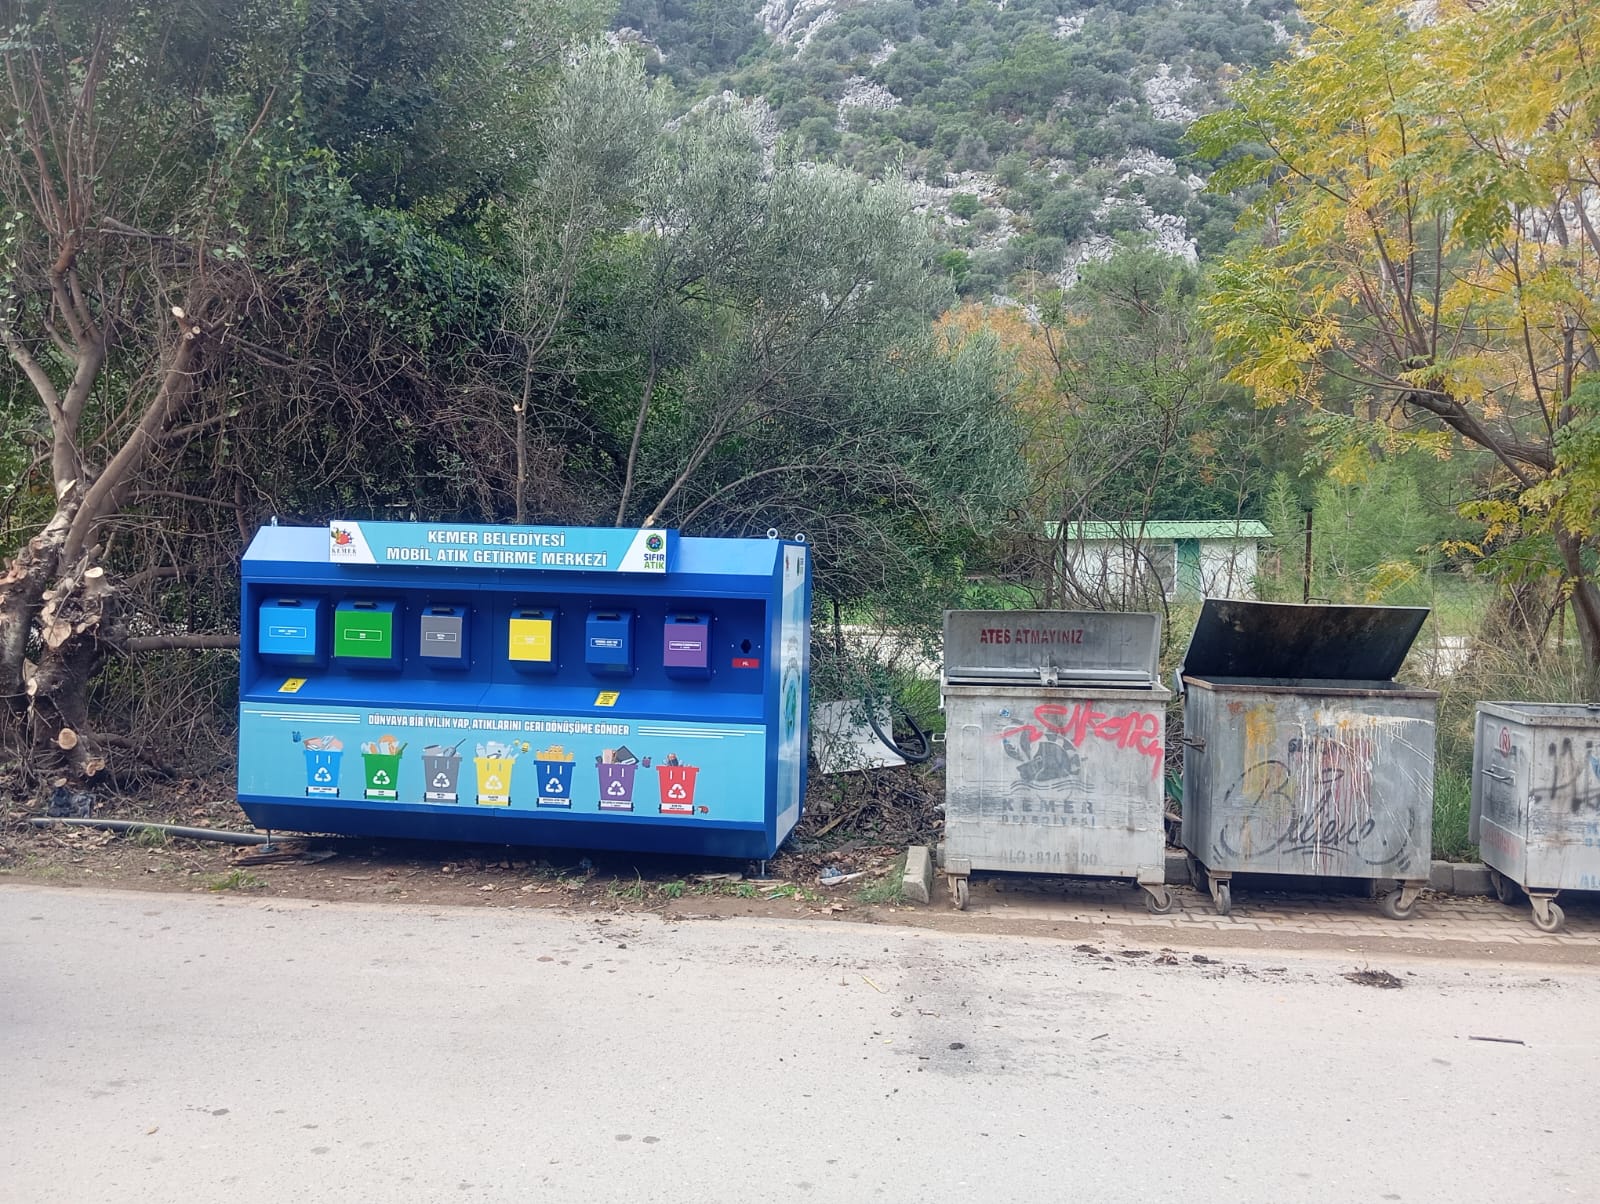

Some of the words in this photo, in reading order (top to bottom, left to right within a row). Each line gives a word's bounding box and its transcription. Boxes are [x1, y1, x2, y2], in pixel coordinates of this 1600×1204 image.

[428, 530, 478, 544] KEMER
[483, 531, 566, 547] BELEDİYESİ
[386, 546, 433, 561] MOBİL
[436, 549, 469, 562] ATIK
[473, 549, 538, 565] GETİRME
[542, 551, 608, 567] MERKEZİ
[643, 553, 665, 561] SIFIR
[643, 561, 665, 569] ATIK
[1014, 628, 1084, 645] ATMAYINIZ
[368, 713, 408, 726] DÜNYAYA
[409, 715, 424, 727] BİR
[425, 715, 451, 729] İYİLİK
[472, 719, 522, 732] ATIKLARINI
[524, 720, 545, 733] GERİ
[545, 720, 594, 736] DÖNÜŞÜME
[594, 722, 630, 736] GÖNDER
[1002, 798, 1094, 814] KEMER
